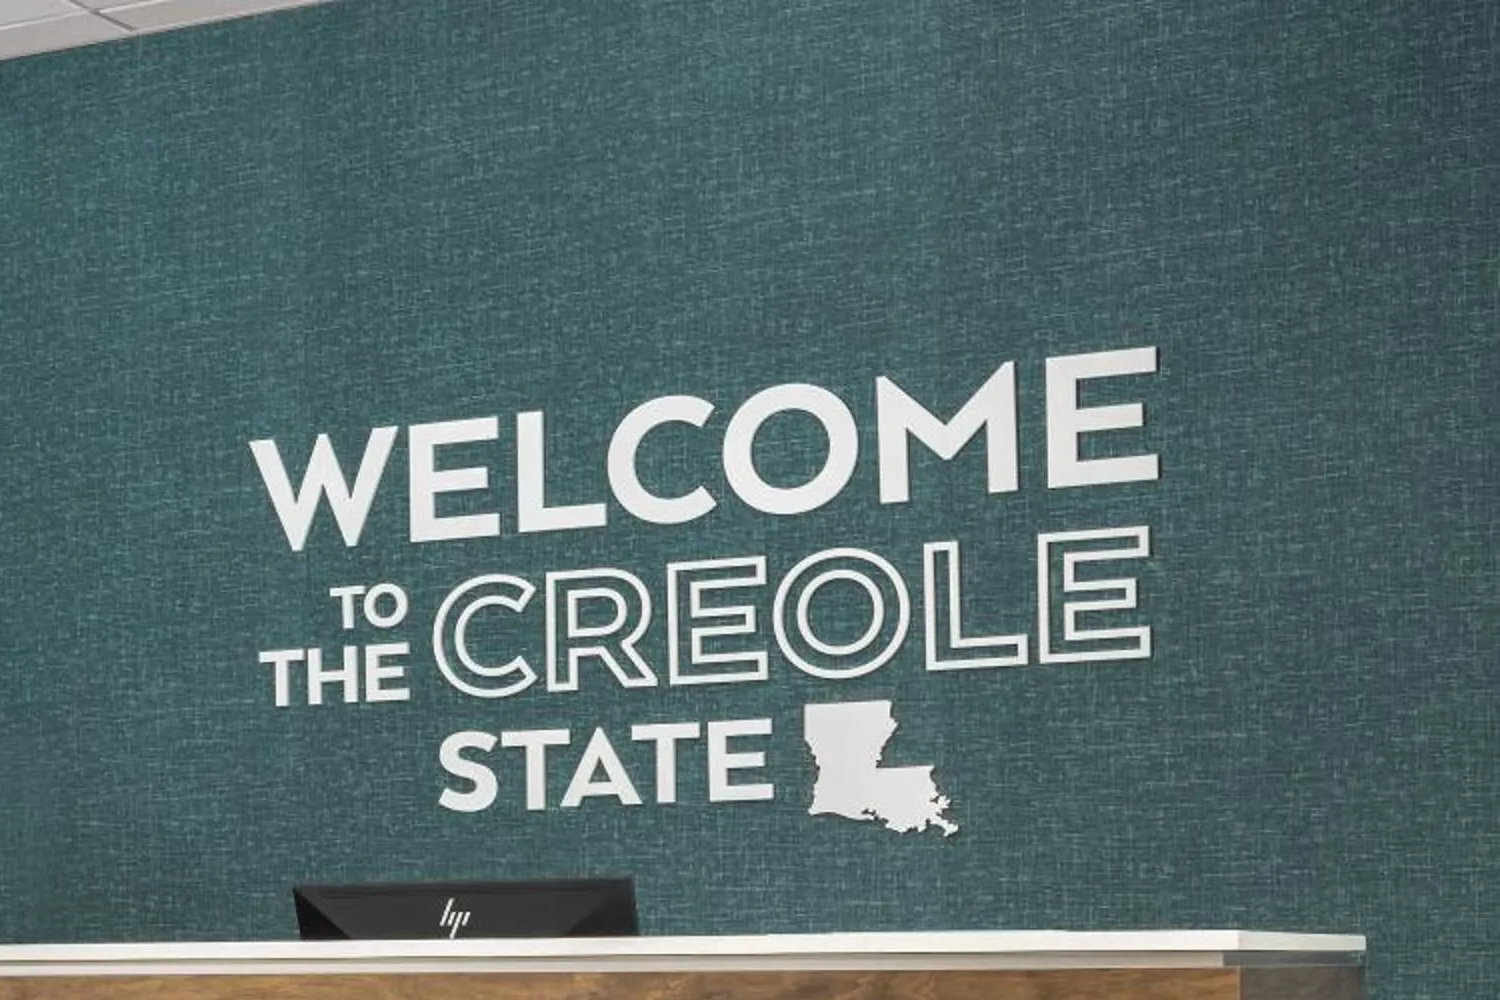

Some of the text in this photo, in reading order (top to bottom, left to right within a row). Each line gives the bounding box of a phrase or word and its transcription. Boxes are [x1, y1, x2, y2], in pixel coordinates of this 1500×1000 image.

[249, 345, 1160, 551] WELCOME
[258, 525, 1152, 707] THE CREOLE
[329, 582, 409, 629] TO
[437, 717, 775, 813] STATE
